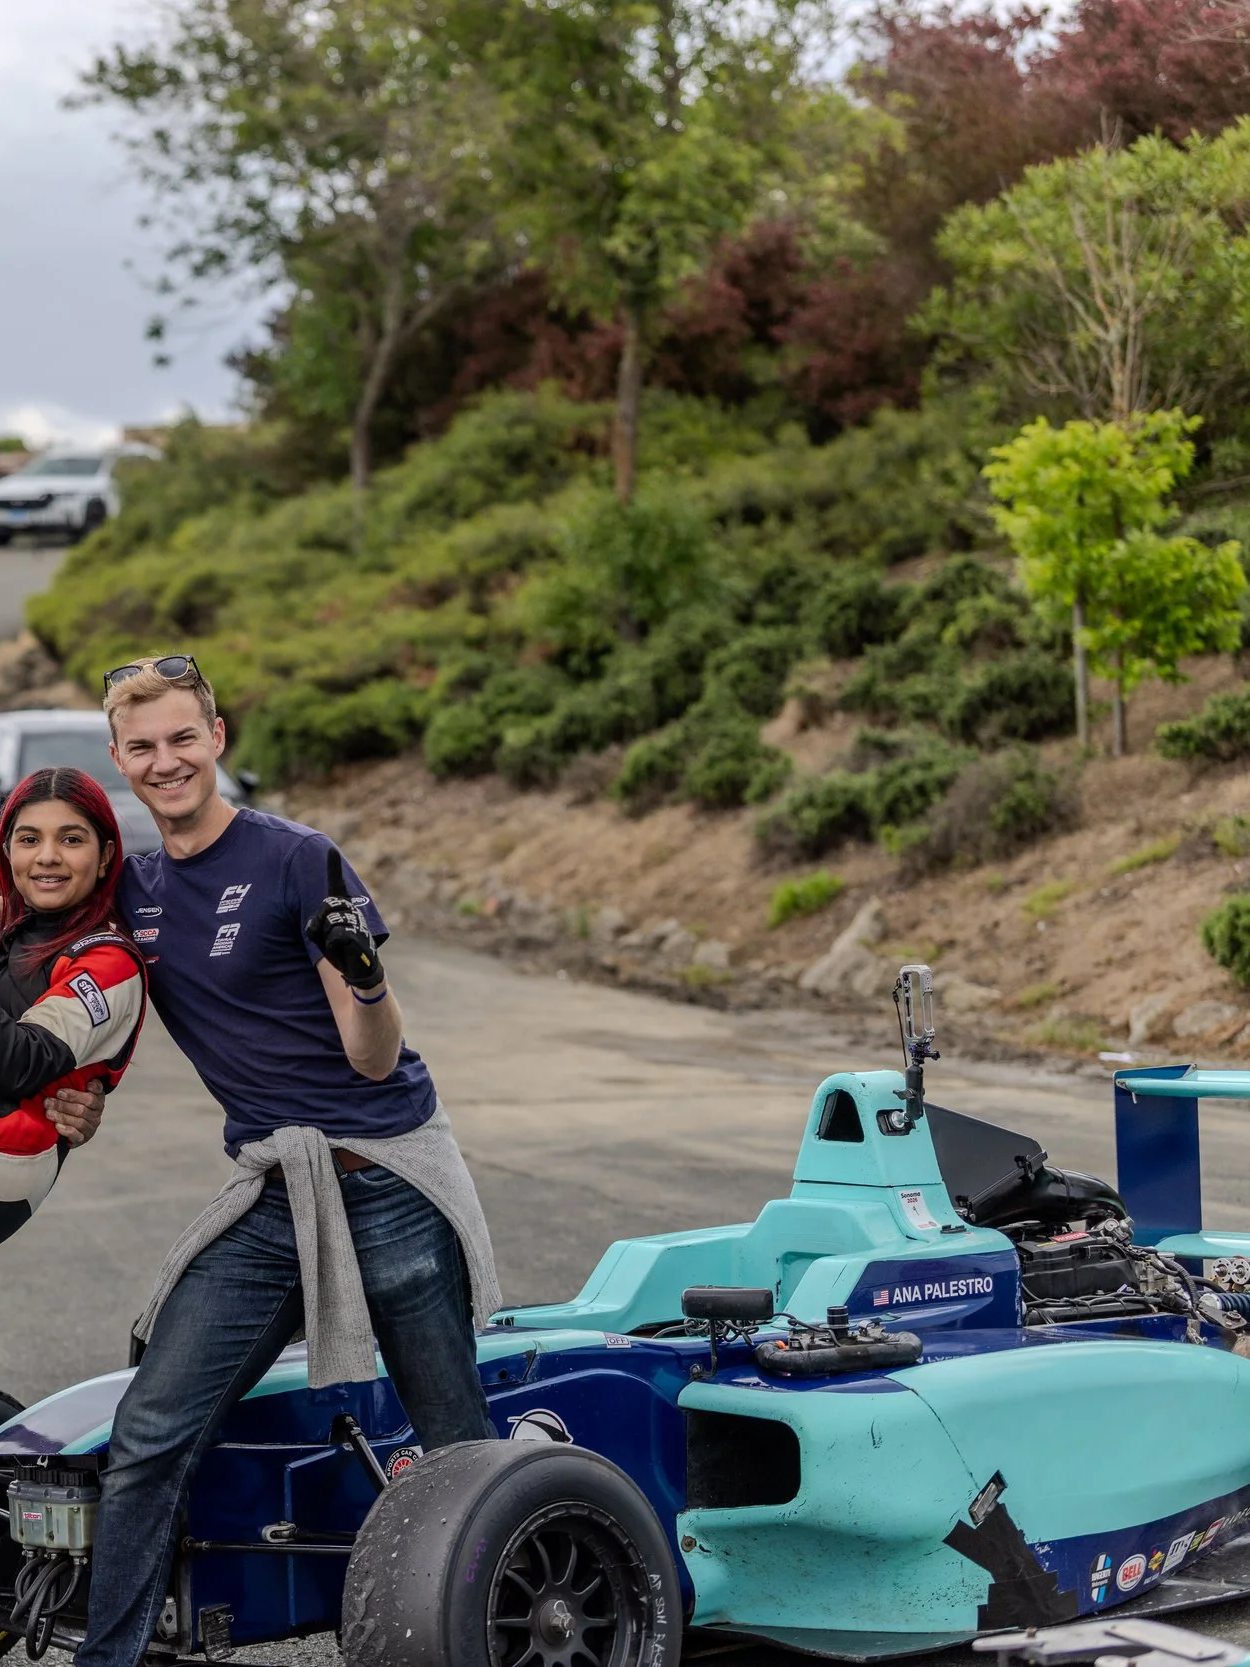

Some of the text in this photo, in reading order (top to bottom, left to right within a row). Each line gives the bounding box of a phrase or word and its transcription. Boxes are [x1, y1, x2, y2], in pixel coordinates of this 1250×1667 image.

[221, 884, 252, 901] F4
[892, 1276, 993, 1304] ANA PALESTRO
[386, 1452, 401, 1477] SPORTS
[1121, 1562, 1141, 1582] BELL
